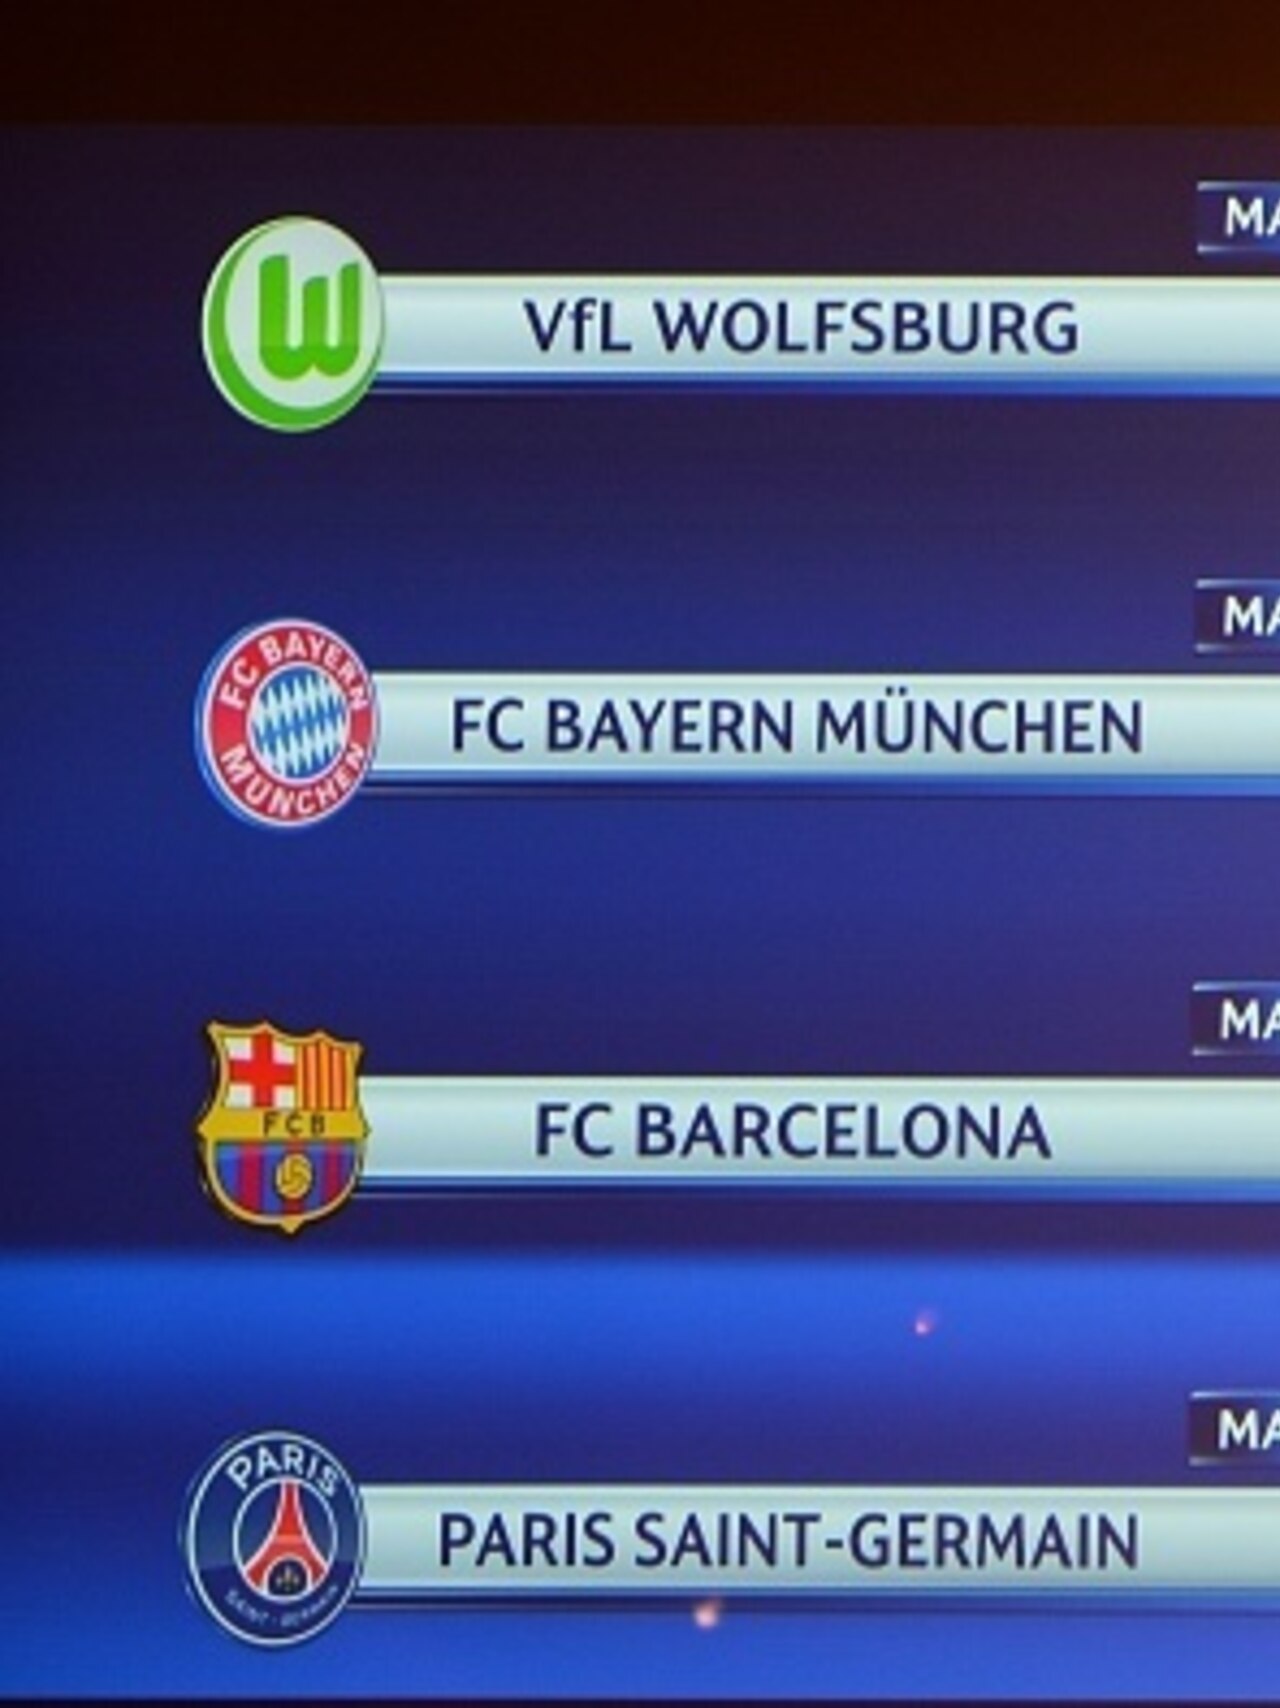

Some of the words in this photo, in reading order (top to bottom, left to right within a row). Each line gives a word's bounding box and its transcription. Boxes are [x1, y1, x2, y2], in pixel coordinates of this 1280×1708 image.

[524, 298, 631, 353] VfL
[653, 300, 1078, 355] WOLFSBURG
[257, 630, 369, 711] BAYERN
[452, 698, 524, 753] FC
[547, 699, 792, 753] BAYERN
[816, 689, 1142, 754] MÜNCHEN
[536, 1103, 614, 1159] FC
[636, 1103, 1052, 1160] BARCELONA
[225, 1442, 340, 1497] PARIS
[439, 1512, 615, 1568] PARIS
[634, 1512, 1138, 1570] SAINT-GERMAIN
